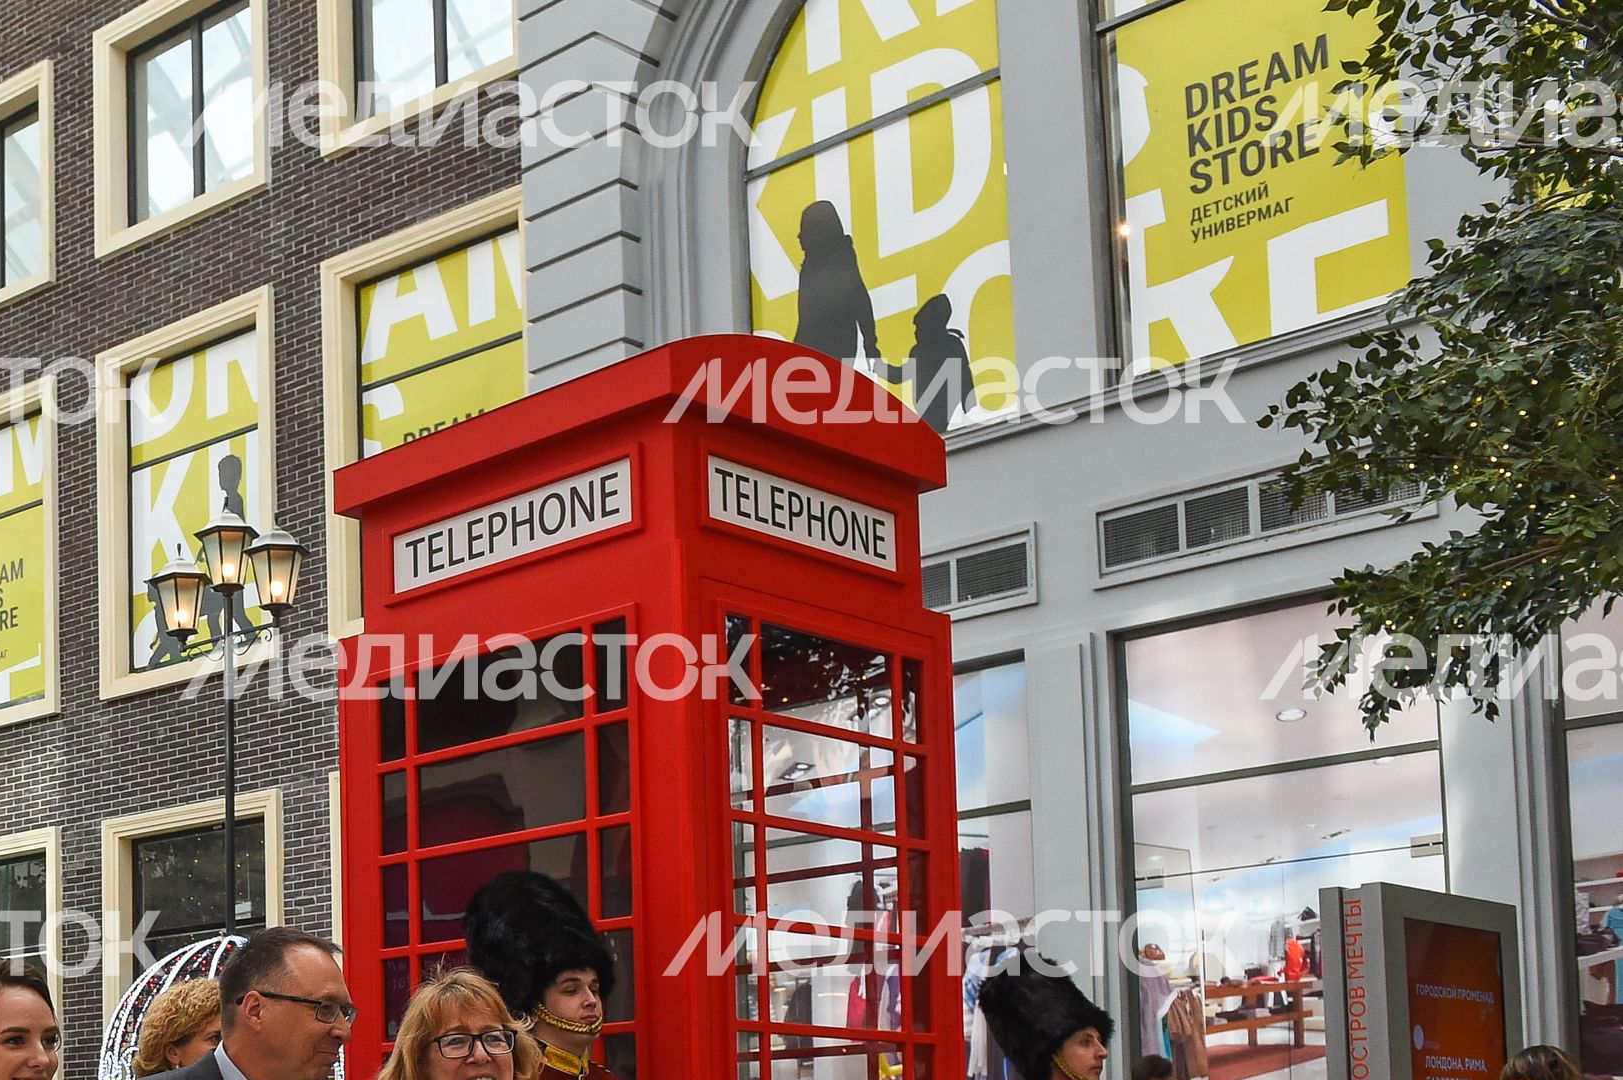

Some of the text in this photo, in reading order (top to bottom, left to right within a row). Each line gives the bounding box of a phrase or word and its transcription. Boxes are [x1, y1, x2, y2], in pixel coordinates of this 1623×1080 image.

[1185, 33, 1329, 119] DREAM
[1187, 95, 1279, 158] KIDS
[1189, 120, 1321, 195] STORE
[1190, 181, 1269, 226] ДЕТСКИЙ
[1191, 196, 1294, 243] УНИВЕРМАГ
[404, 471, 621, 579] TELEPHONE
[714, 466, 888, 561] TELEPHONE
[1344, 899, 1370, 1080] ОСТРОВ МЕЧТЫ
[1416, 983, 1495, 1005] ГОРОДСКОЙ ПРОМЕНАД
[1425, 1055, 1488, 1073] ЛОНДОНА, РИМА,
